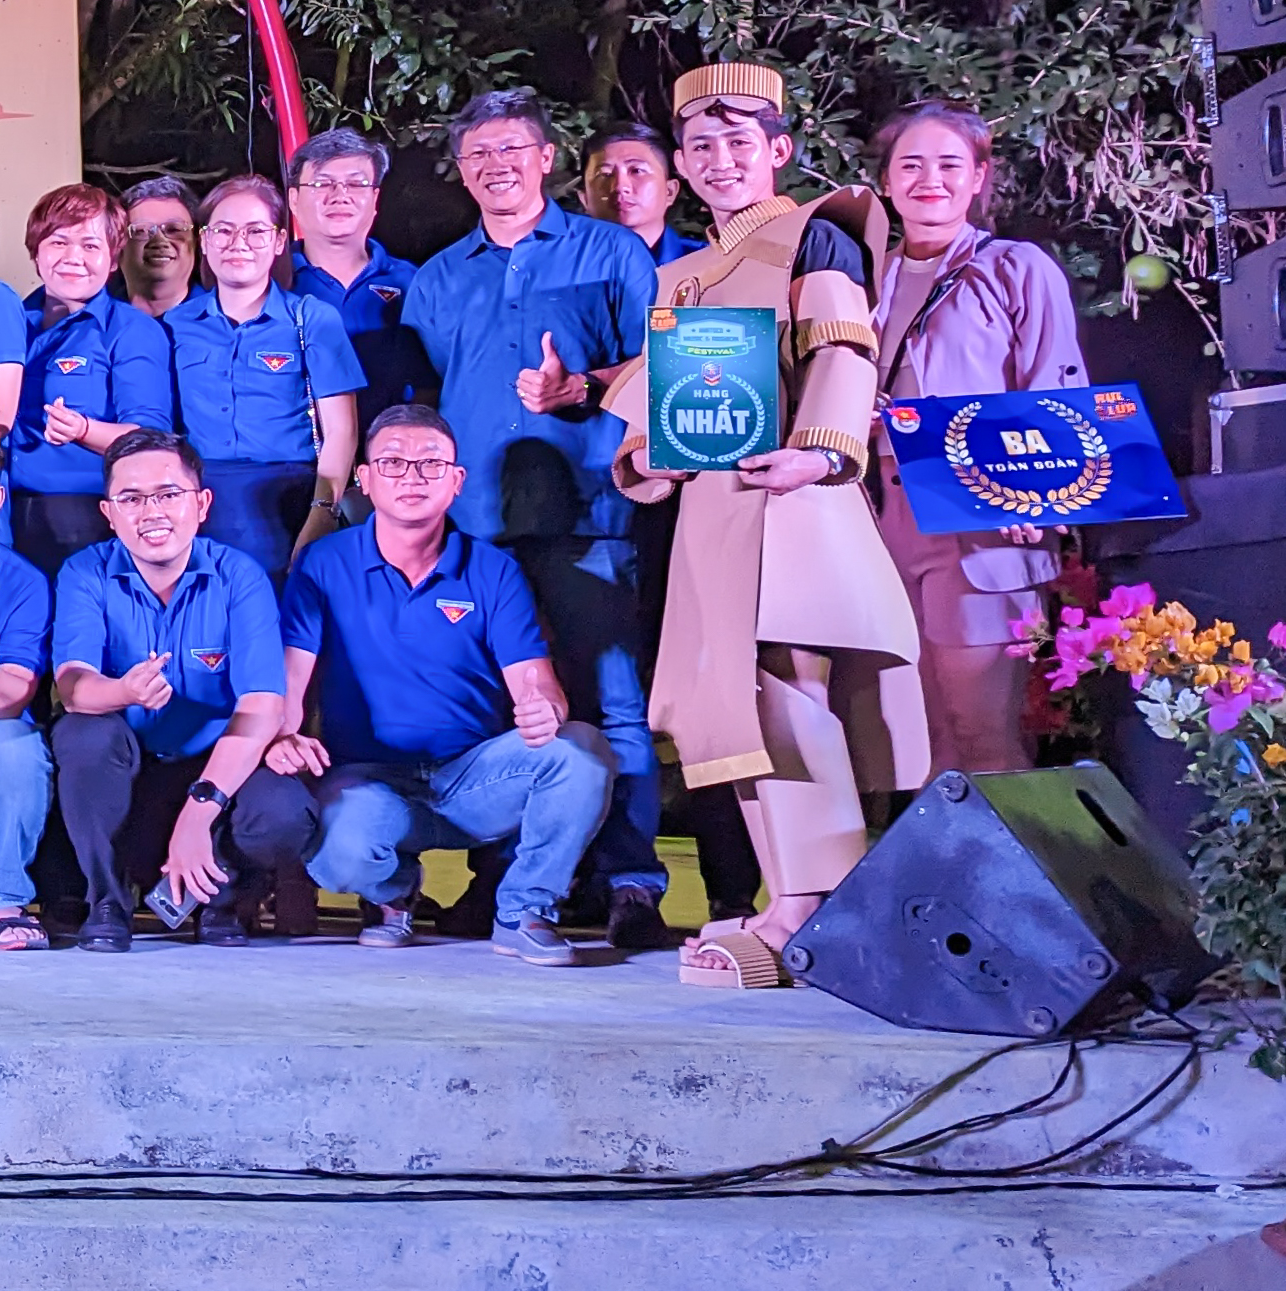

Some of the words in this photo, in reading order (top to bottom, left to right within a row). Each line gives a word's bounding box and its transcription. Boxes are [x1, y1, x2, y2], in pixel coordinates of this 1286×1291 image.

[687, 347, 736, 356] FESTIVAL
[693, 389, 729, 400] HẠNG
[675, 398, 750, 435] NHẤT
[999, 429, 1053, 456] BA
[985, 460, 1029, 473] TOÀN
[1033, 457, 1079, 470] ĐOÀN
